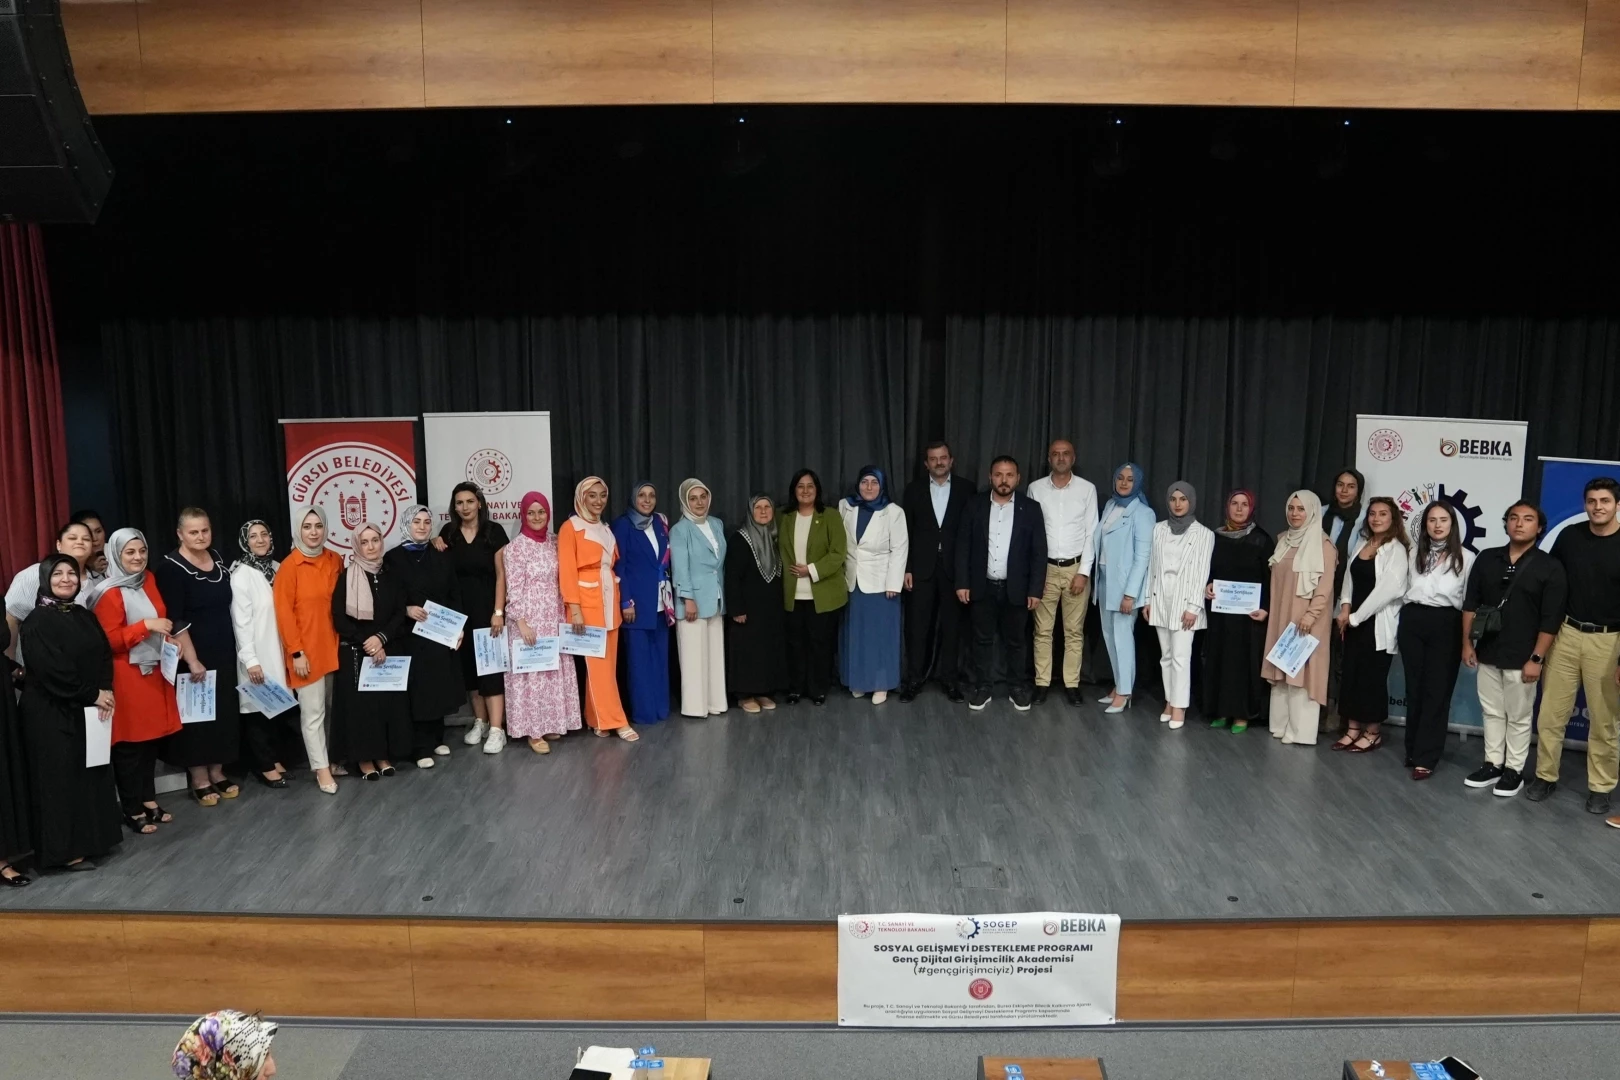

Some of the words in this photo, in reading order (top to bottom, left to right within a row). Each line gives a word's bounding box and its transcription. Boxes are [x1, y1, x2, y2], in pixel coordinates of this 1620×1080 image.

[1459, 439, 1512, 457] BEBKA
[292, 461, 329, 503] GÜRSU
[333, 455, 413, 502] BELEDİYESİ
[487, 500, 509, 509] NAYİ
[1060, 918, 1106, 932] BEBKA
[873, 944, 914, 952] SOSYAL
[916, 943, 969, 954] GELİŞMEYİ
[971, 944, 1036, 952] DESTEKLEME
[1037, 944, 1093, 952] PROGRAMI
[892, 955, 918, 966] Genç
[921, 955, 952, 965] Dijital
[954, 955, 1014, 965] Girişimcilik
[1017, 954, 1074, 963] Akademisi
[913, 965, 1014, 976] (#gençgirişimciyiz)
[1017, 965, 1053, 975] Projesi
